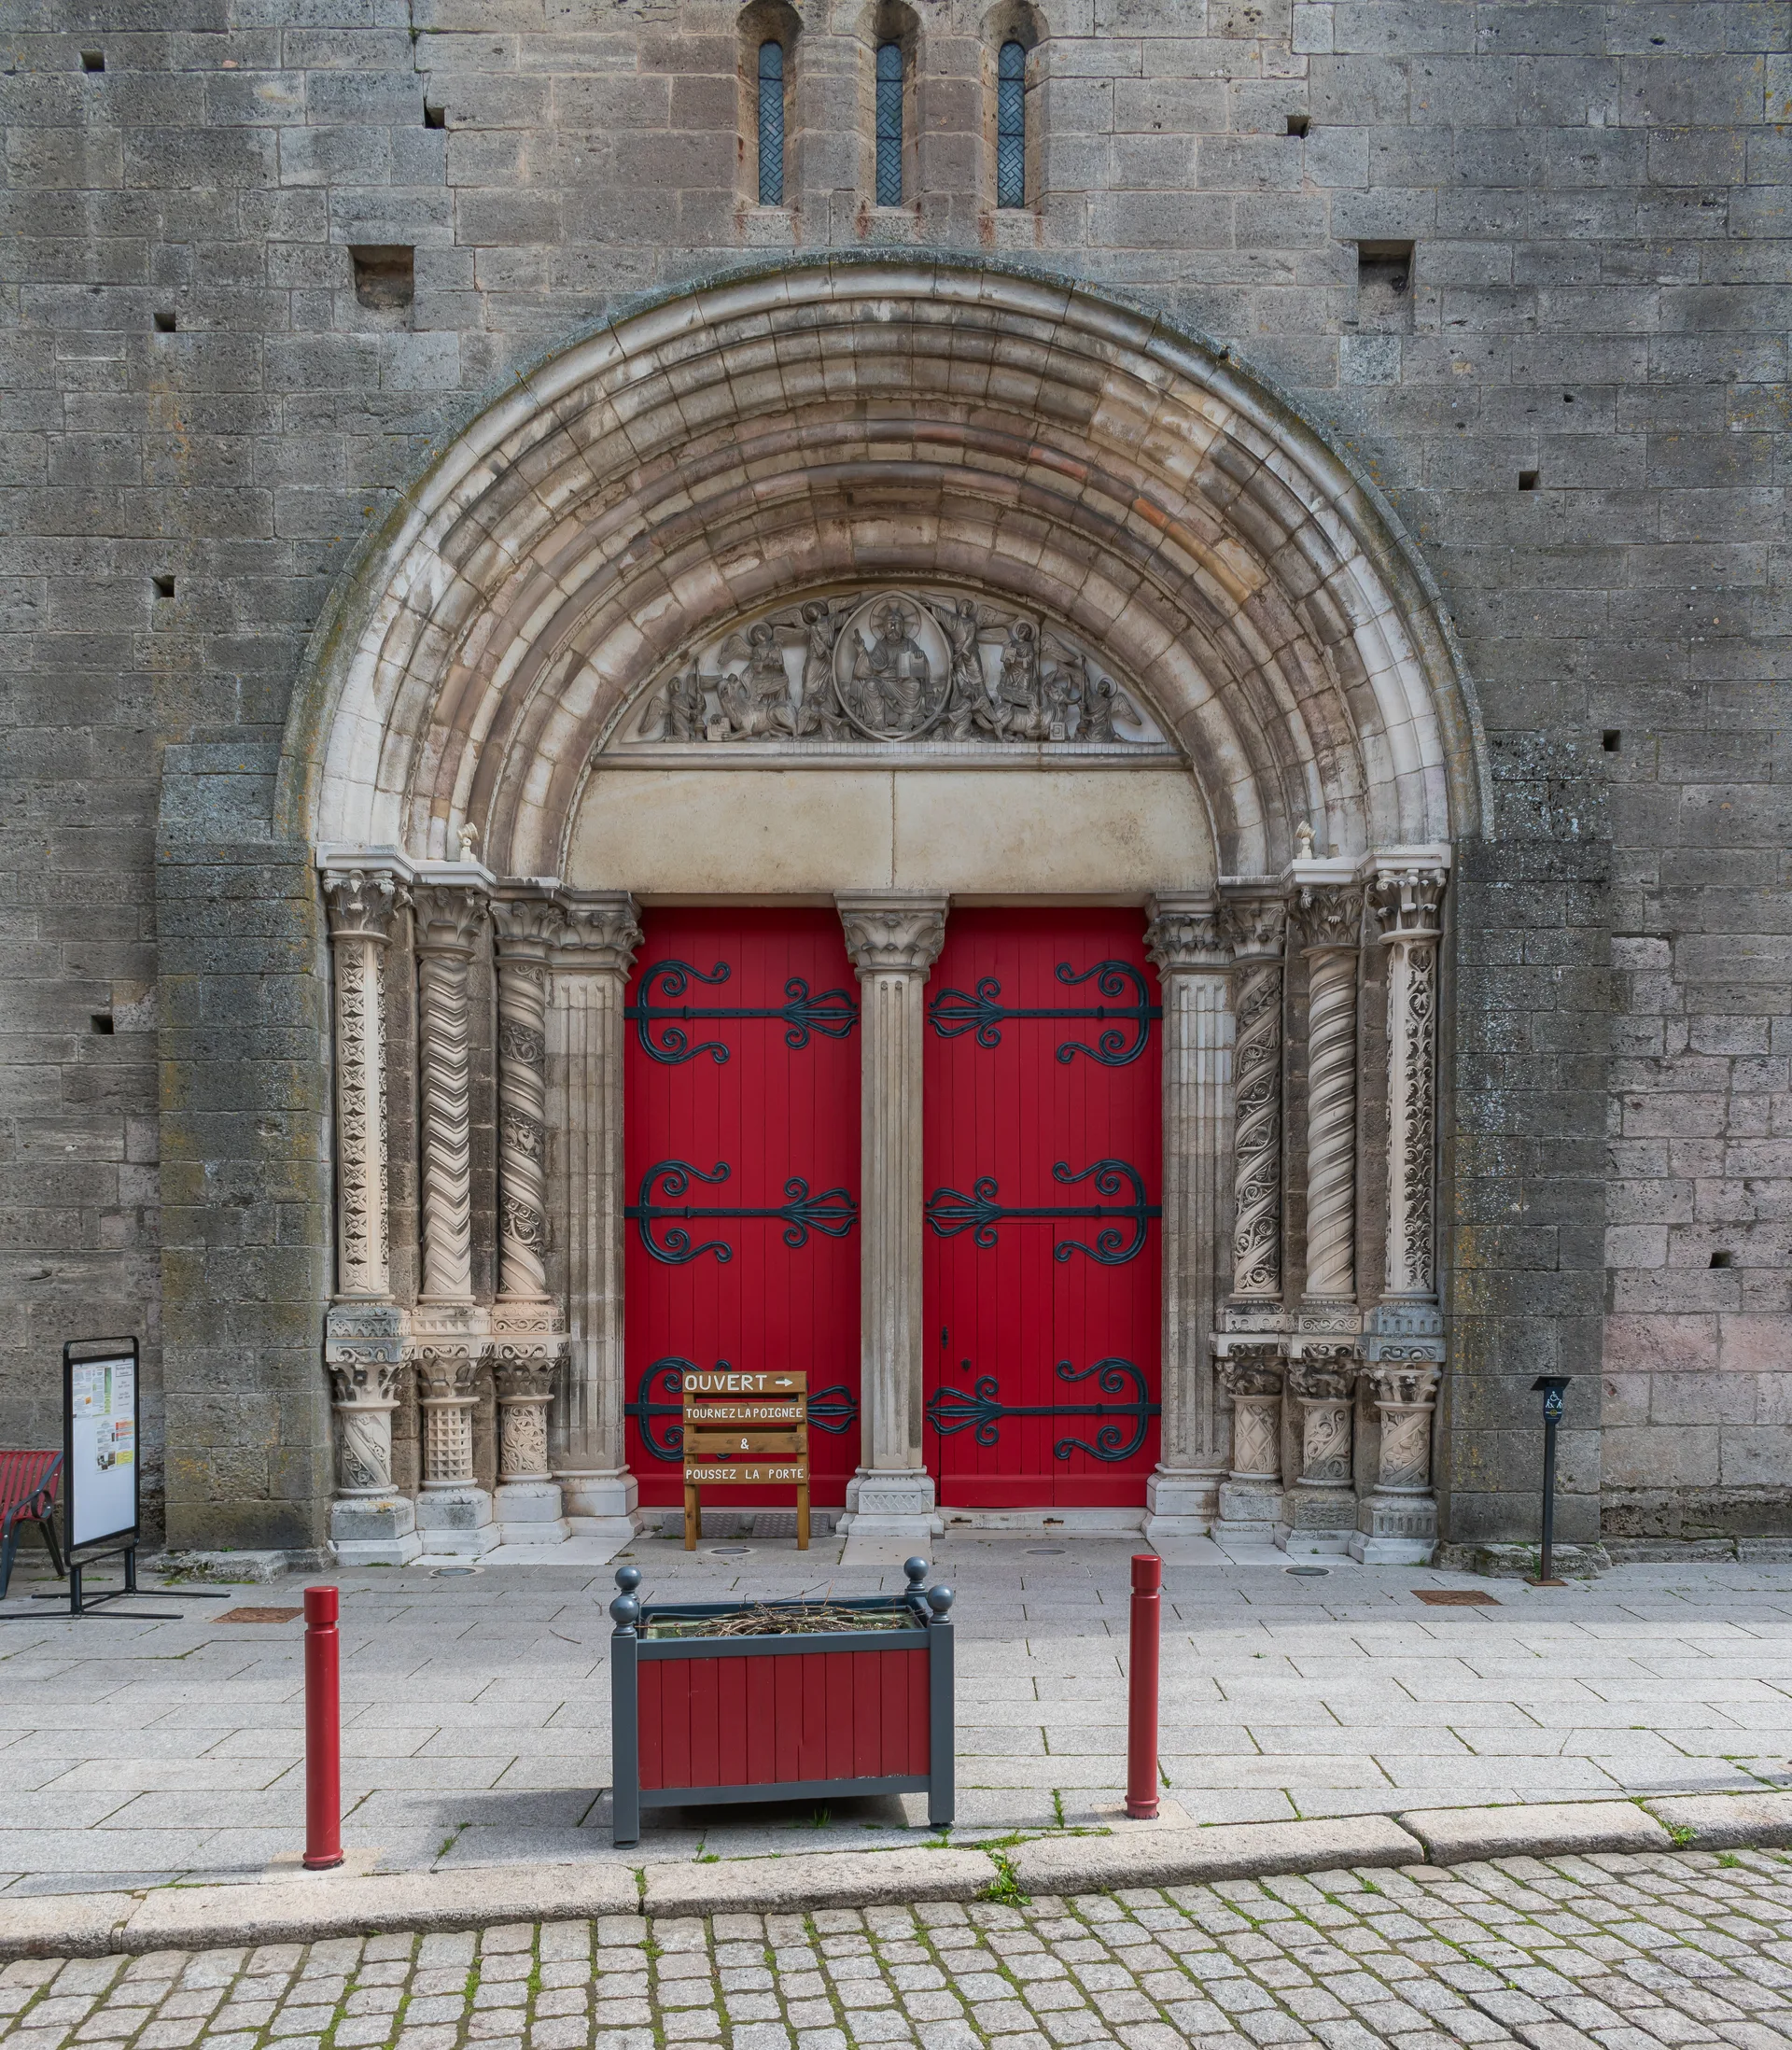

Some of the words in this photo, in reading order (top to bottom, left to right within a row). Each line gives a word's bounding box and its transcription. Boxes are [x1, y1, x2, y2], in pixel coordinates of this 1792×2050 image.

[684, 1374, 768, 1391] OUVERT
[685, 1408, 736, 1419] TOURNEZ
[737, 1408, 751, 1419] LA
[752, 1407, 804, 1418] POIGNEE
[740, 1438, 749, 1451] &
[685, 1468, 737, 1480] POUSSEZ
[745, 1468, 760, 1480] LA
[768, 1468, 805, 1480] PORTE
